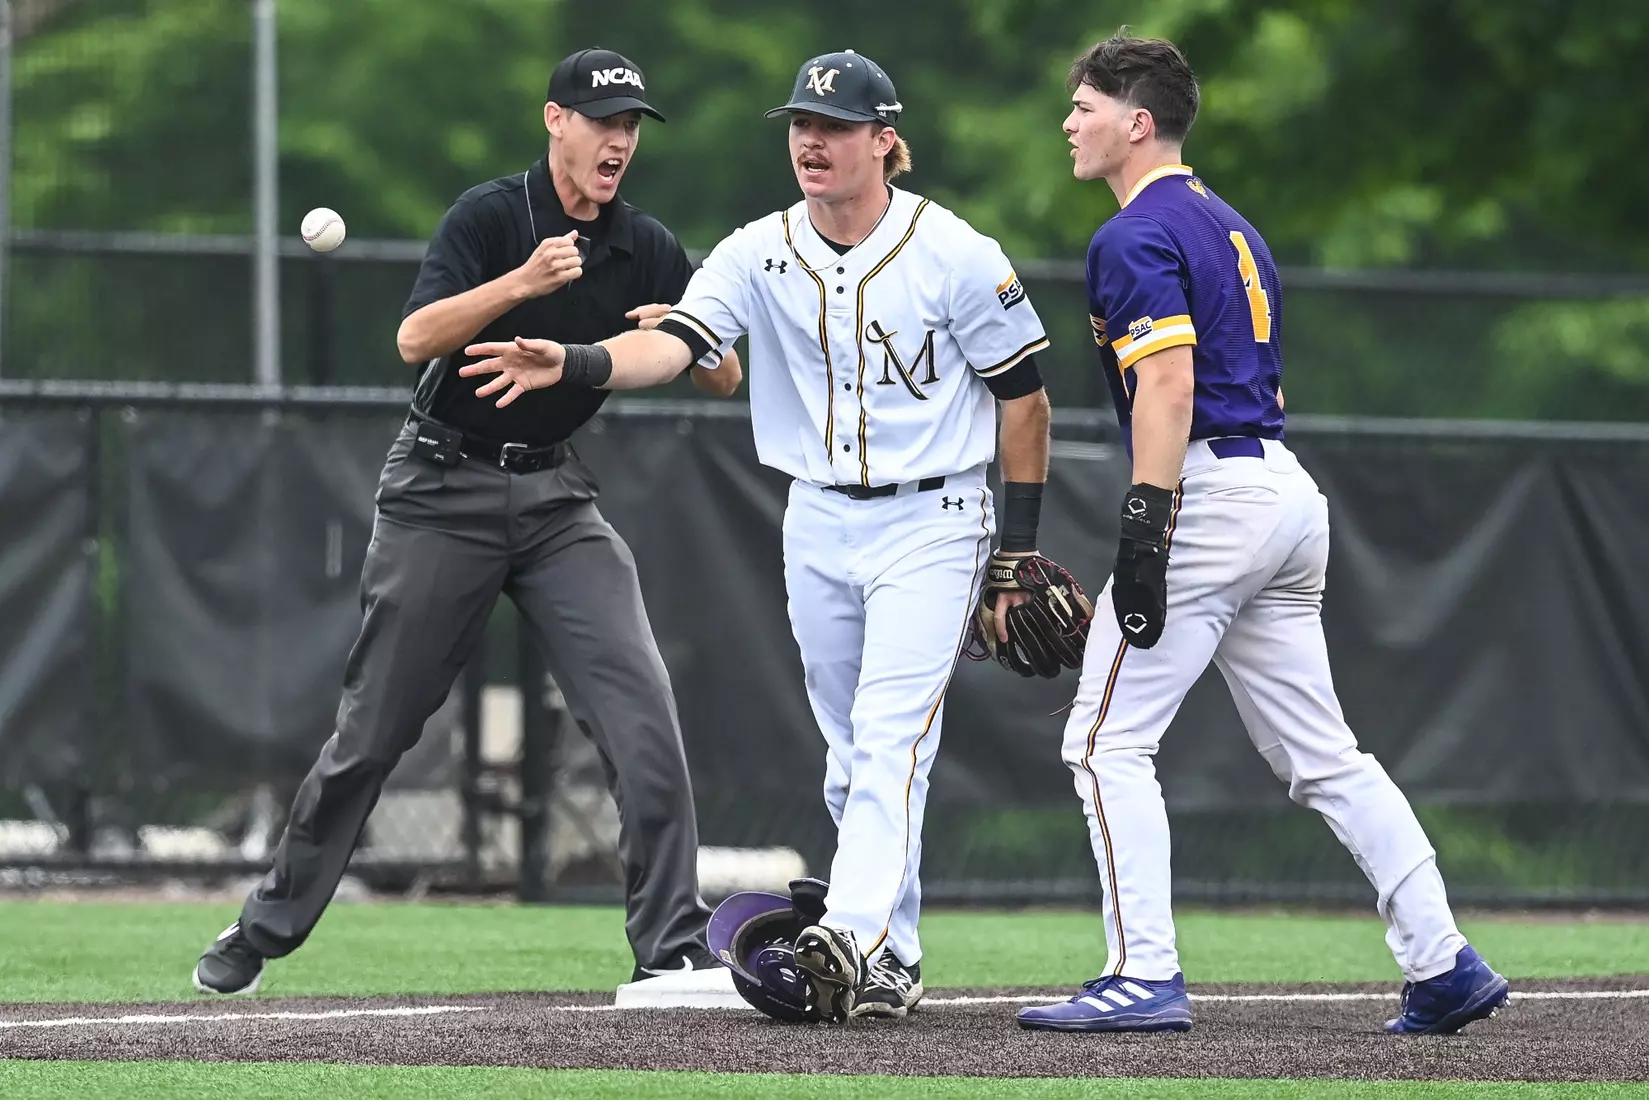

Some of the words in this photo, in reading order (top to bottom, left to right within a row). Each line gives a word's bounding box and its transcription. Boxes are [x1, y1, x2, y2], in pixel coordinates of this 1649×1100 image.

[591, 67, 645, 91] NCAA
[805, 66, 840, 96] M
[998, 279, 1022, 306] PSA
[1130, 320, 1152, 337] PSAC
[865, 319, 941, 400] M
